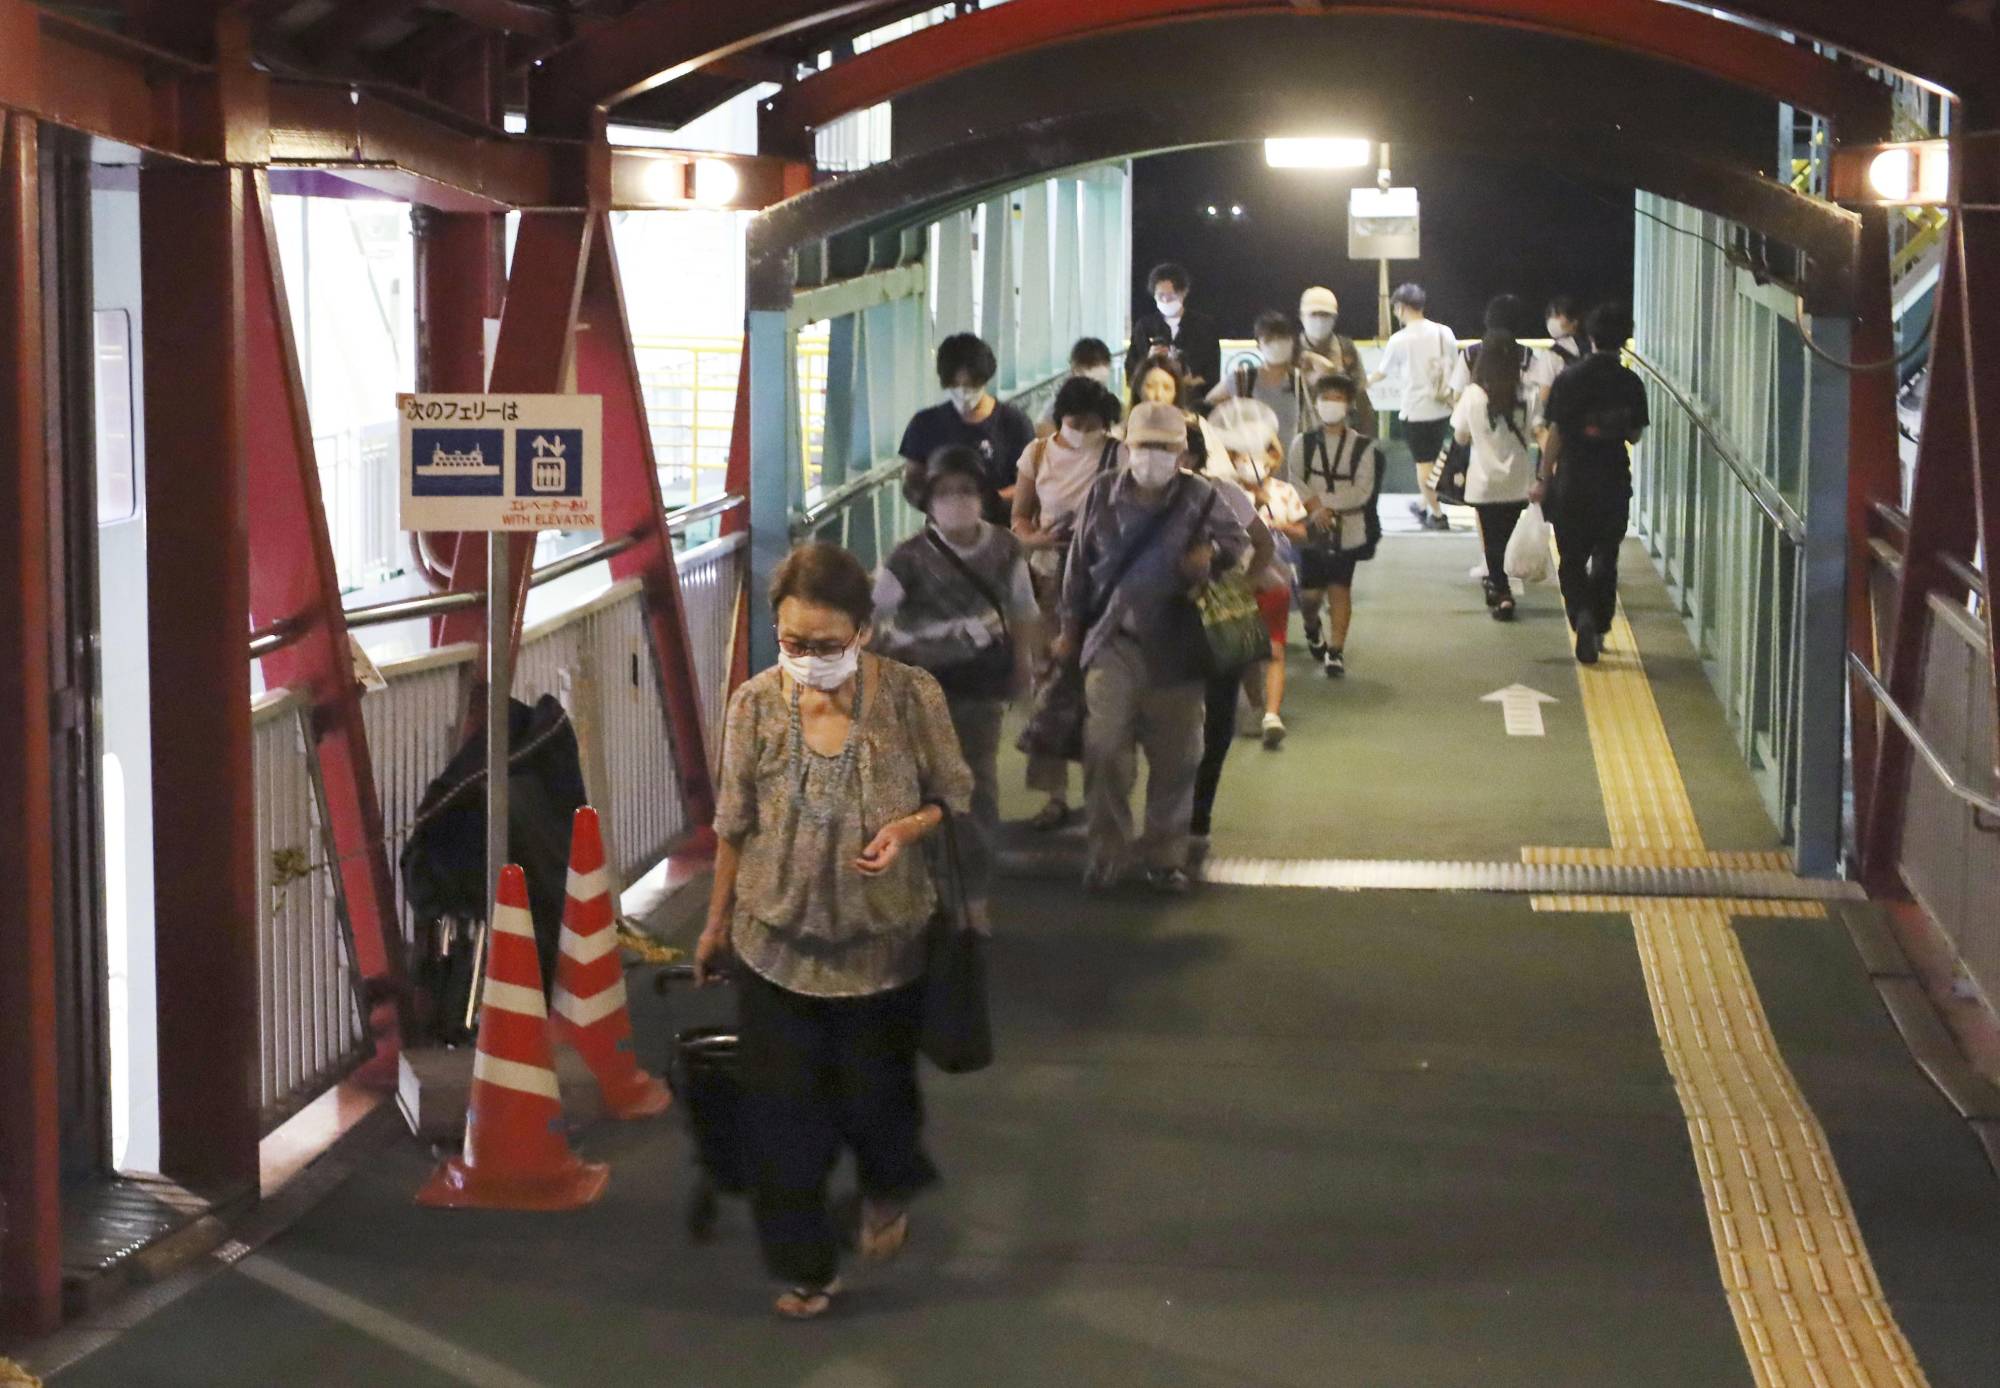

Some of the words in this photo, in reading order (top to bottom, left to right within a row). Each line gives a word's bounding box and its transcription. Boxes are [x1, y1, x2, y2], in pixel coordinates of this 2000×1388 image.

[406, 401, 519, 421] 次のフェリーは
[502, 514, 530, 525] WITH
[535, 514, 595, 525] ELEVATOR
